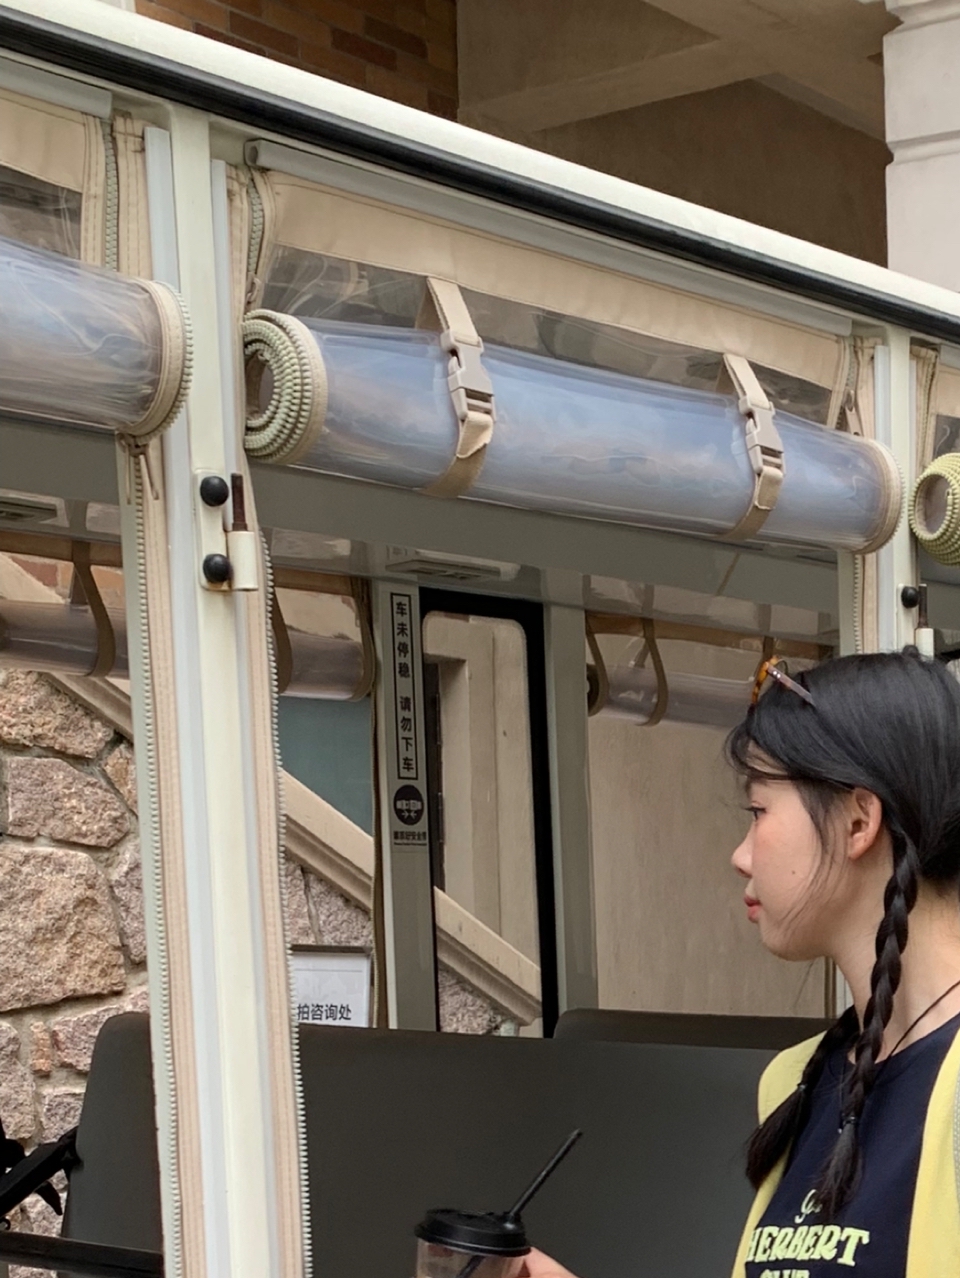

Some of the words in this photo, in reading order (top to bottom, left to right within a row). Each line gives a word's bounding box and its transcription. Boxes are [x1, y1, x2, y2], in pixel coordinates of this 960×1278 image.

[395, 600, 411, 679] 车未停稳
[399, 695, 415, 773] 请勿下车
[297, 1002, 352, 1022] 拍咨询处
